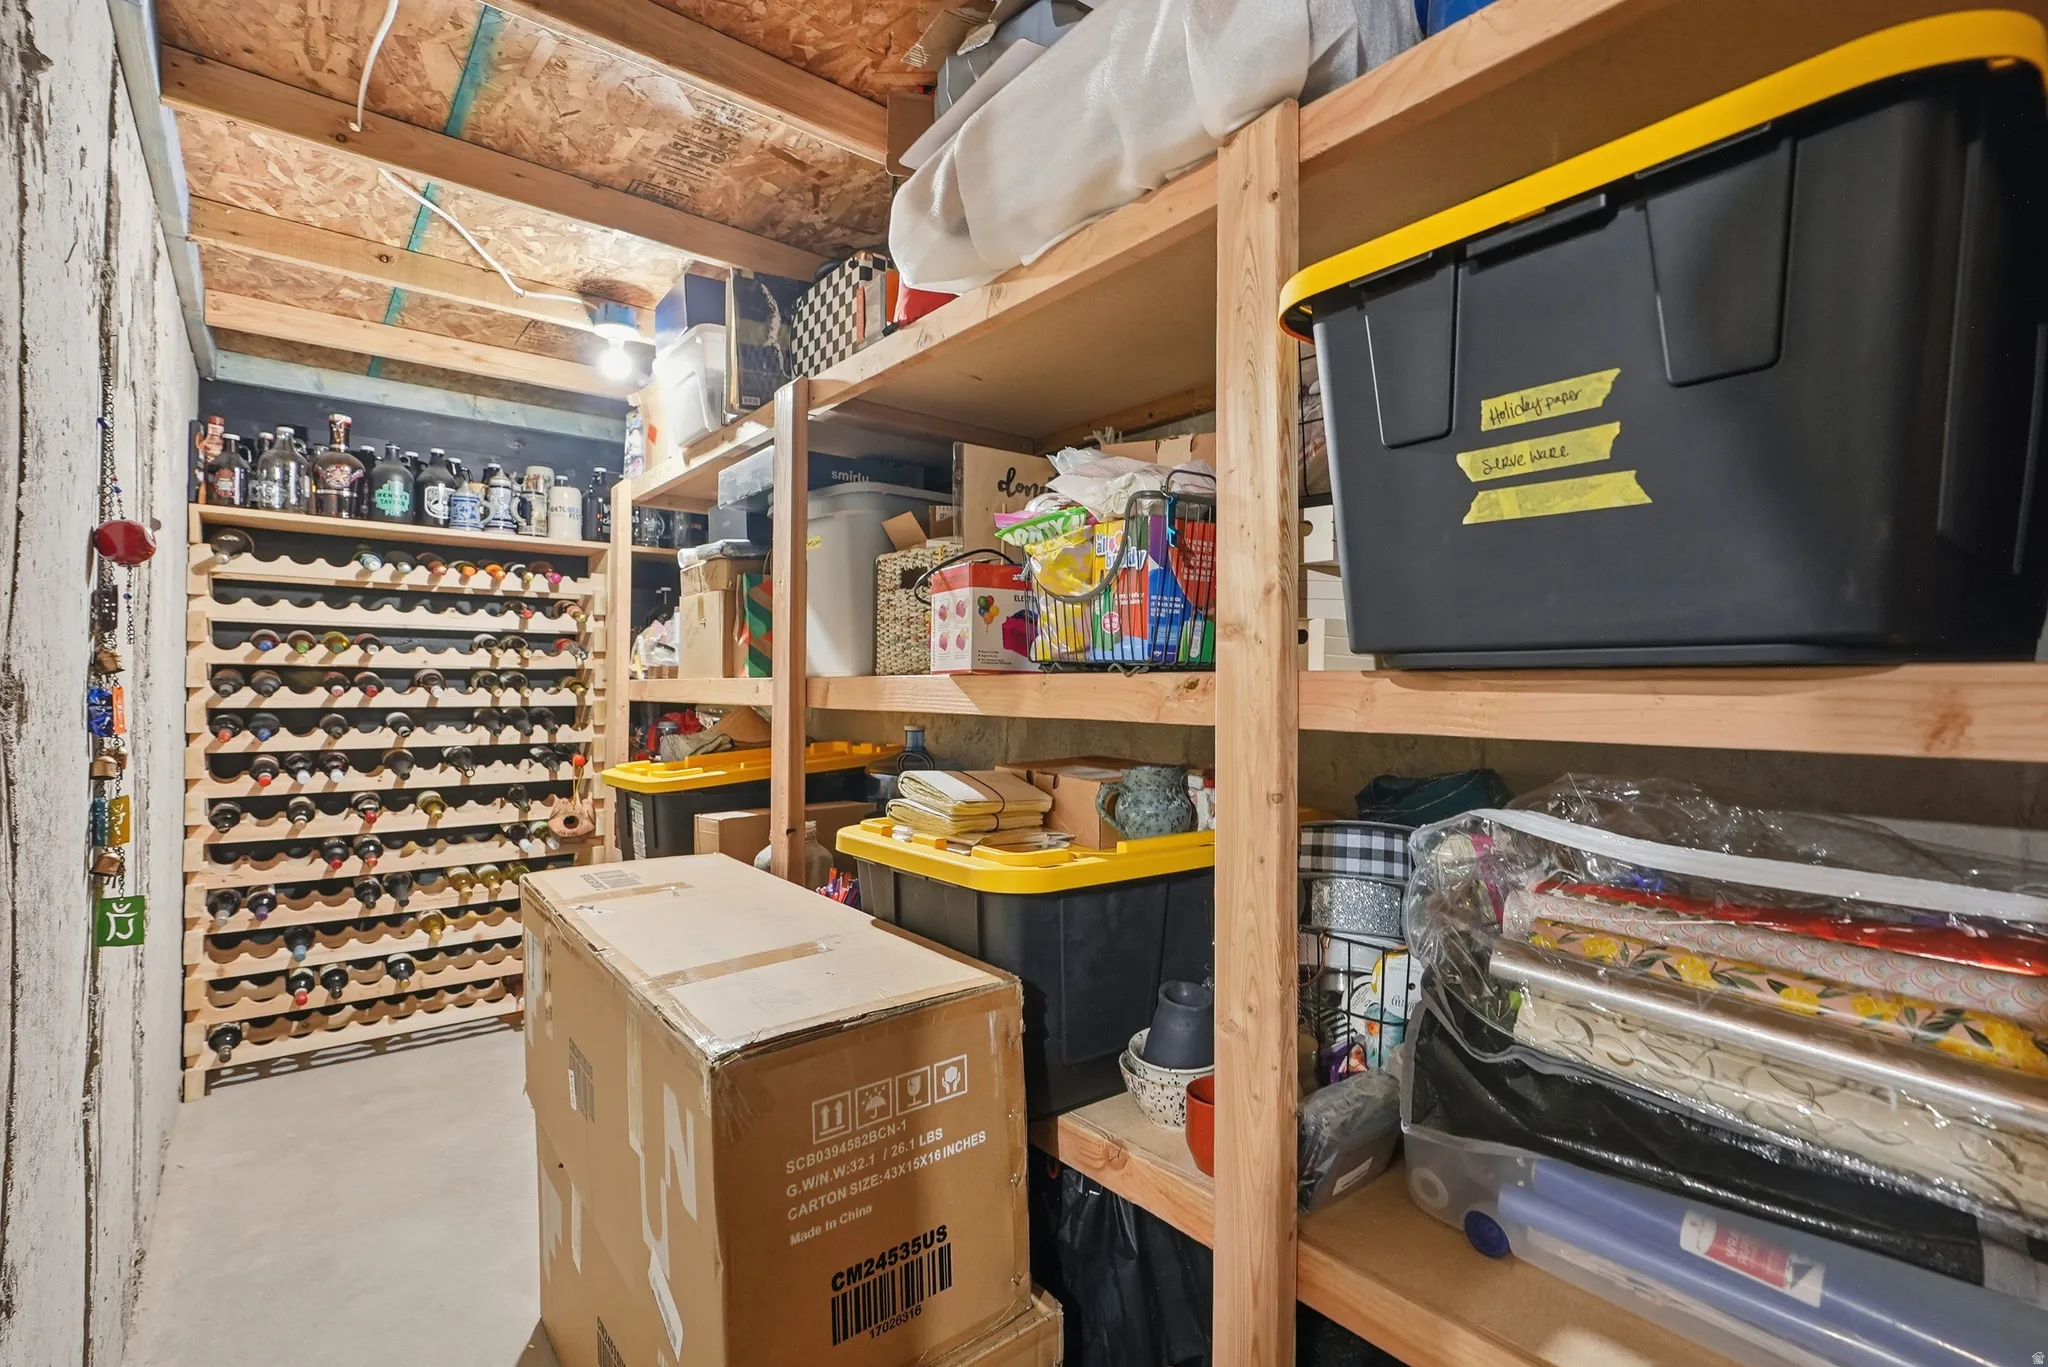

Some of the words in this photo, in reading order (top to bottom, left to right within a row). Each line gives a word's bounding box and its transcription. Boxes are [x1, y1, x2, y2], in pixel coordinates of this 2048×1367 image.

[1545, 389, 1582, 410] paper
[786, 1119, 907, 1174] SCB0394582BCN-1
[891, 1137, 916, 1159] 26.1
[919, 1127, 943, 1147] LBS
[788, 1186, 847, 1221] CARTON
[942, 1130, 986, 1158] INCHES
[790, 1225, 822, 1246] Made
[839, 1204, 873, 1225] China
[831, 1224, 947, 1292] CM24535US
[869, 1304, 922, 1339] 17026316
